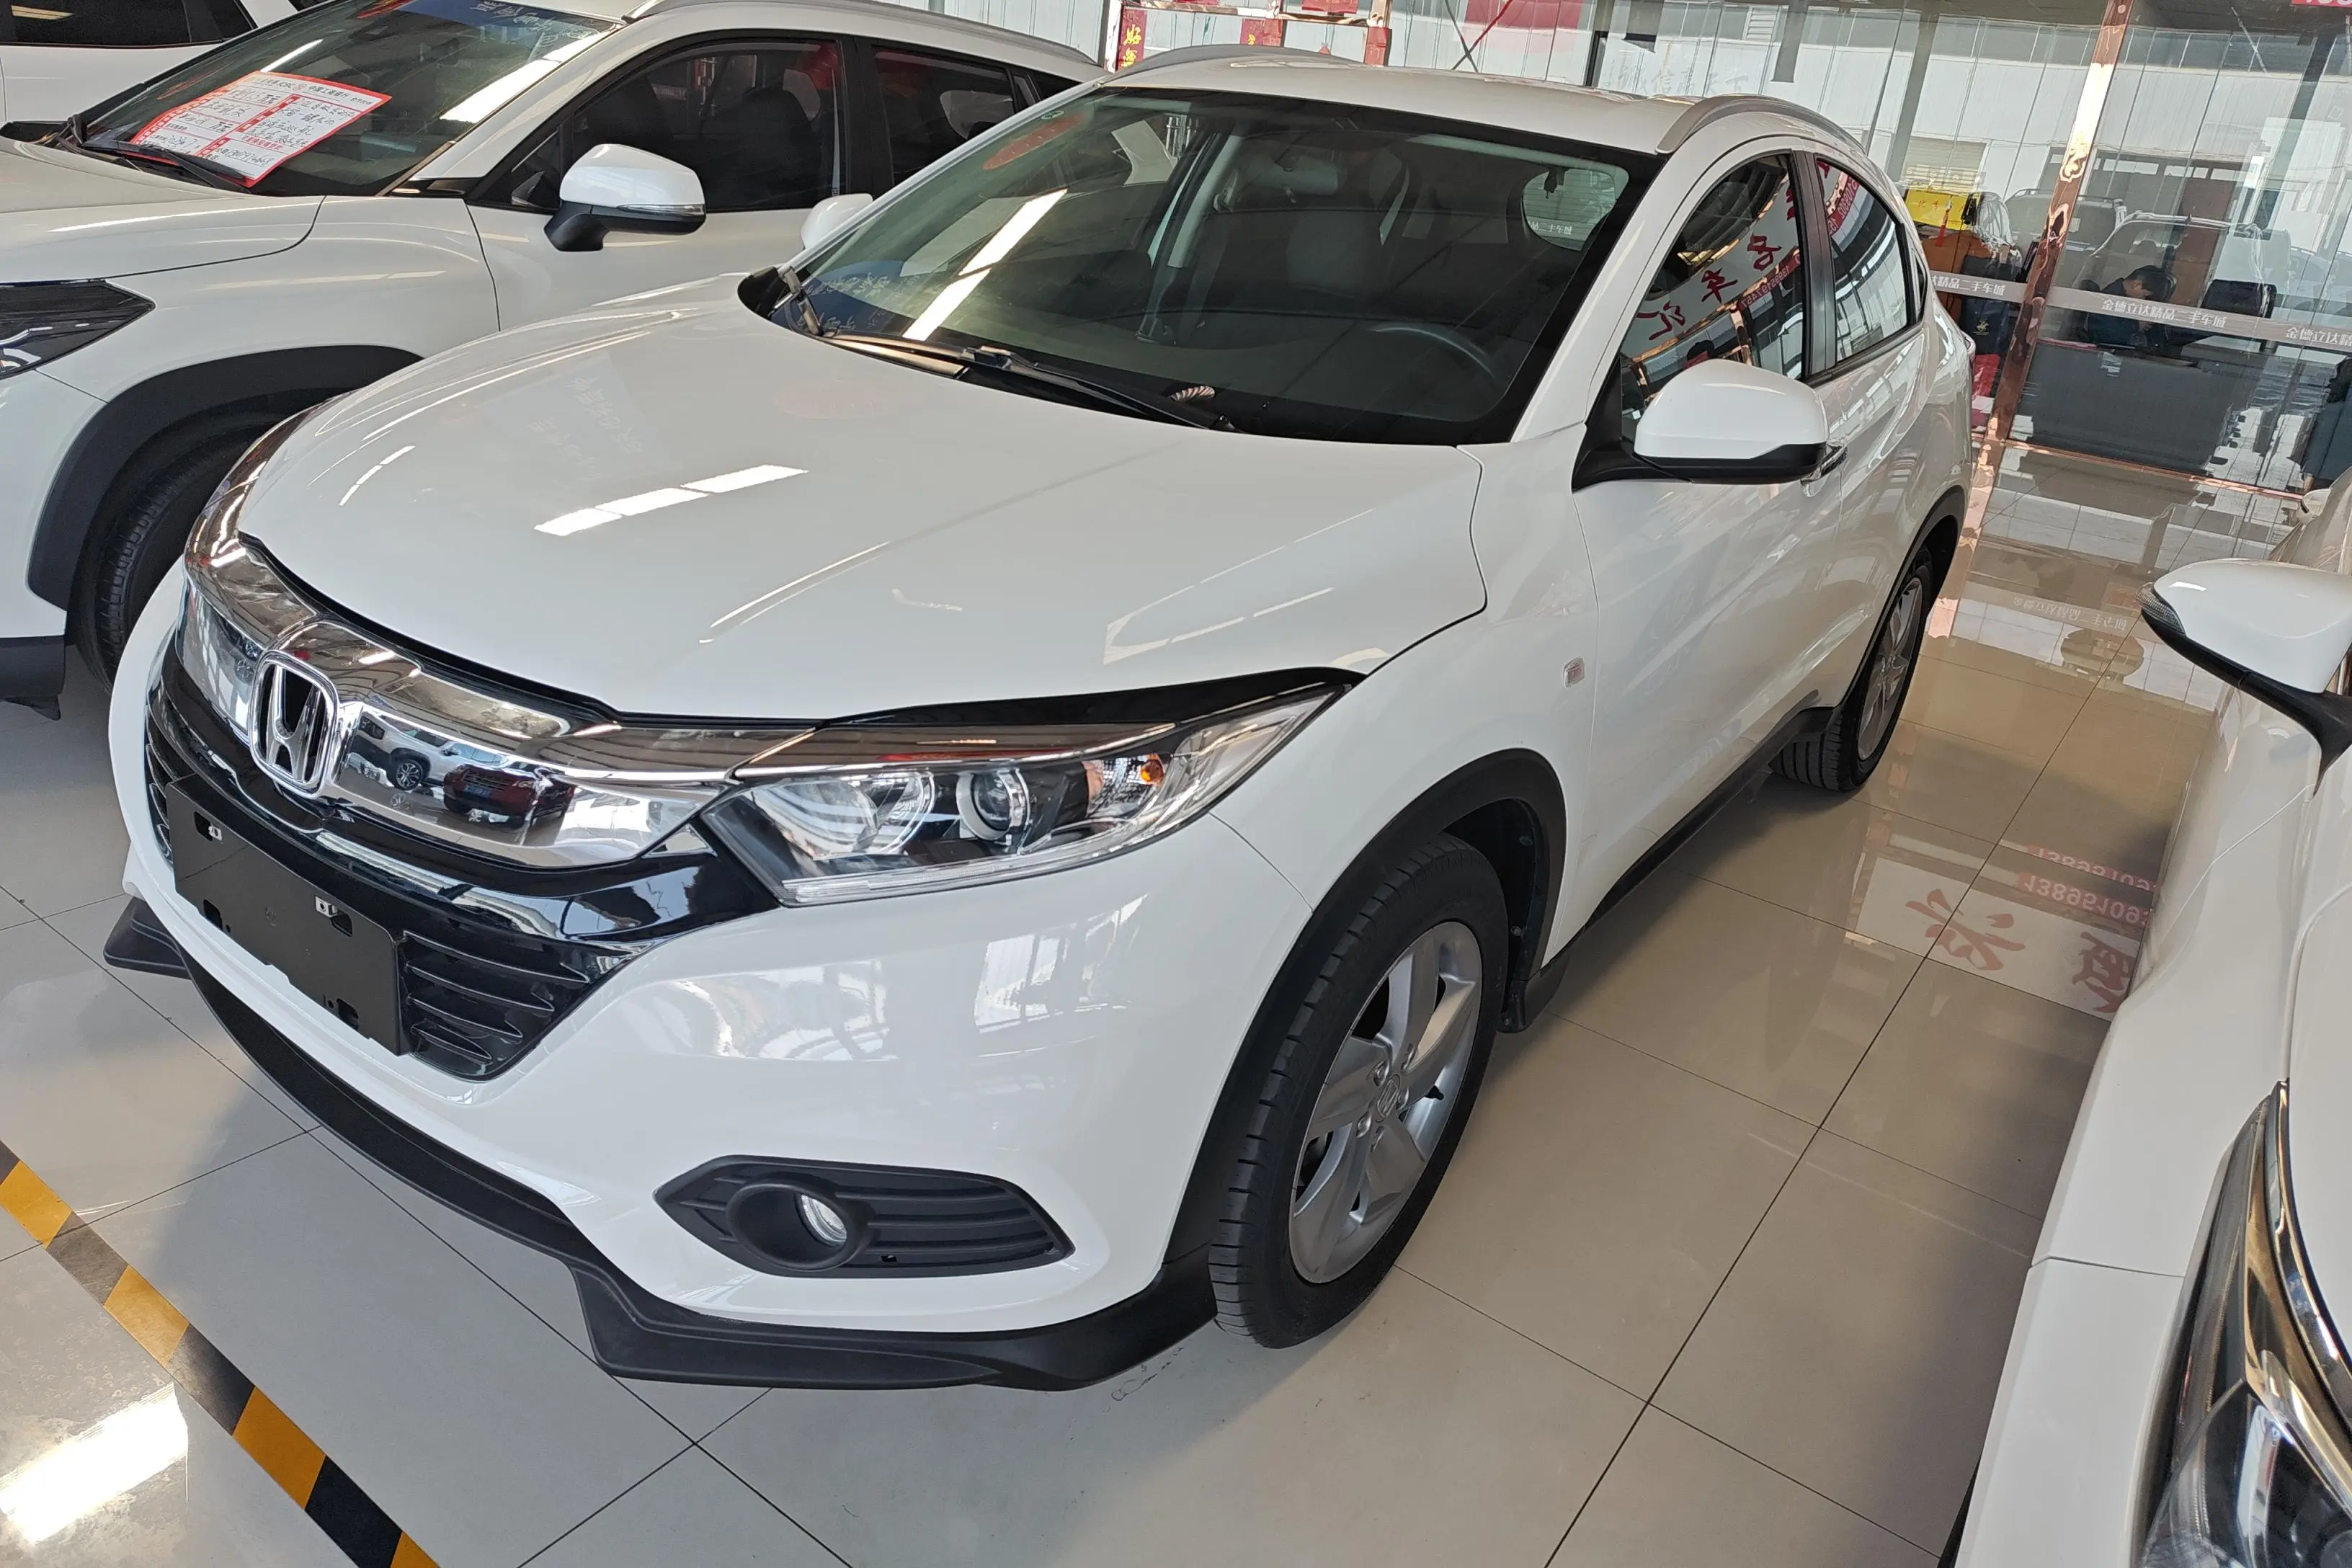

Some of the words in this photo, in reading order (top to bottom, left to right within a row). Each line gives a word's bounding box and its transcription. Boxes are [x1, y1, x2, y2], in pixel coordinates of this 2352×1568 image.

[2101, 298, 2227, 329] 金德立达精品二手车城
